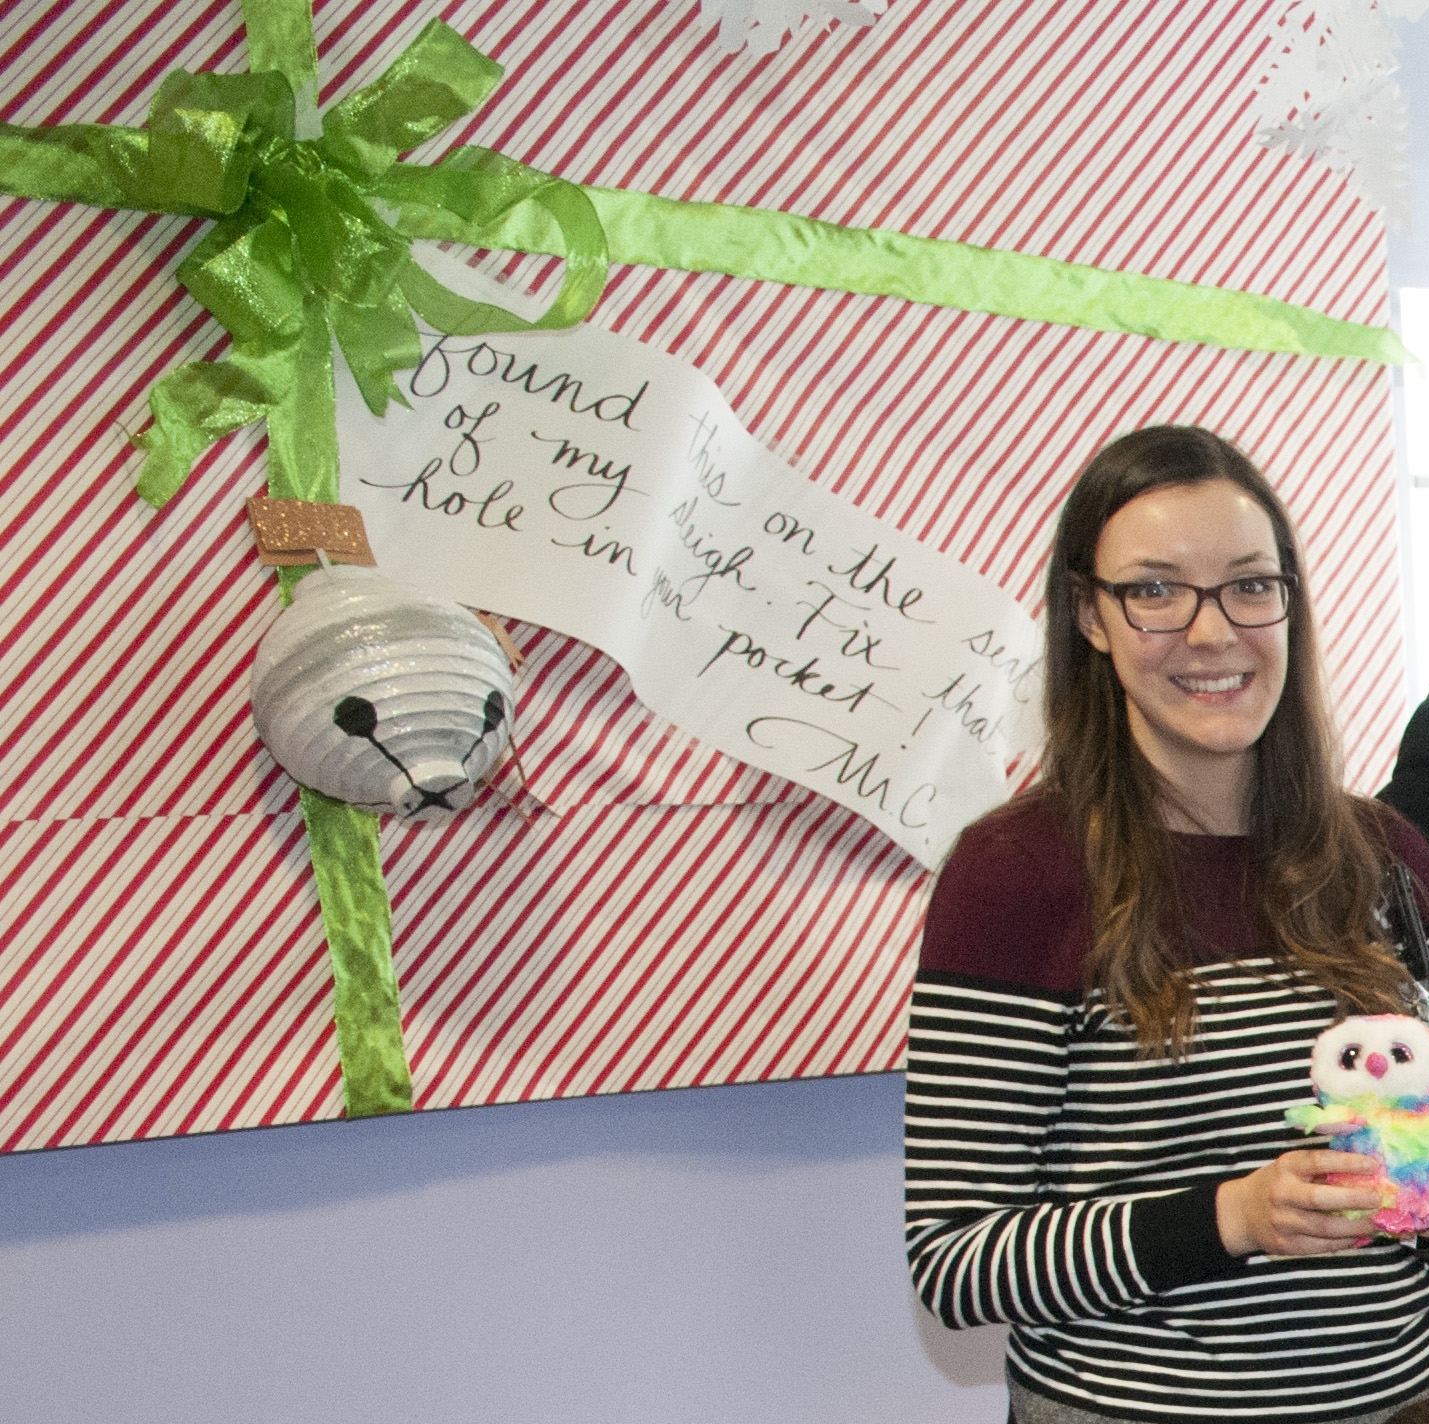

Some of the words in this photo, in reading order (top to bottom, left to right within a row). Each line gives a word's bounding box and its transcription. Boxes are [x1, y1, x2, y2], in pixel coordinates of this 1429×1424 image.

[359, 457, 525, 532] hole
[551, 525, 638, 576] in
[443, 401, 501, 477] of
[531, 430, 651, 521] my
[763, 511, 816, 556] on
[827, 543, 937, 624] the
